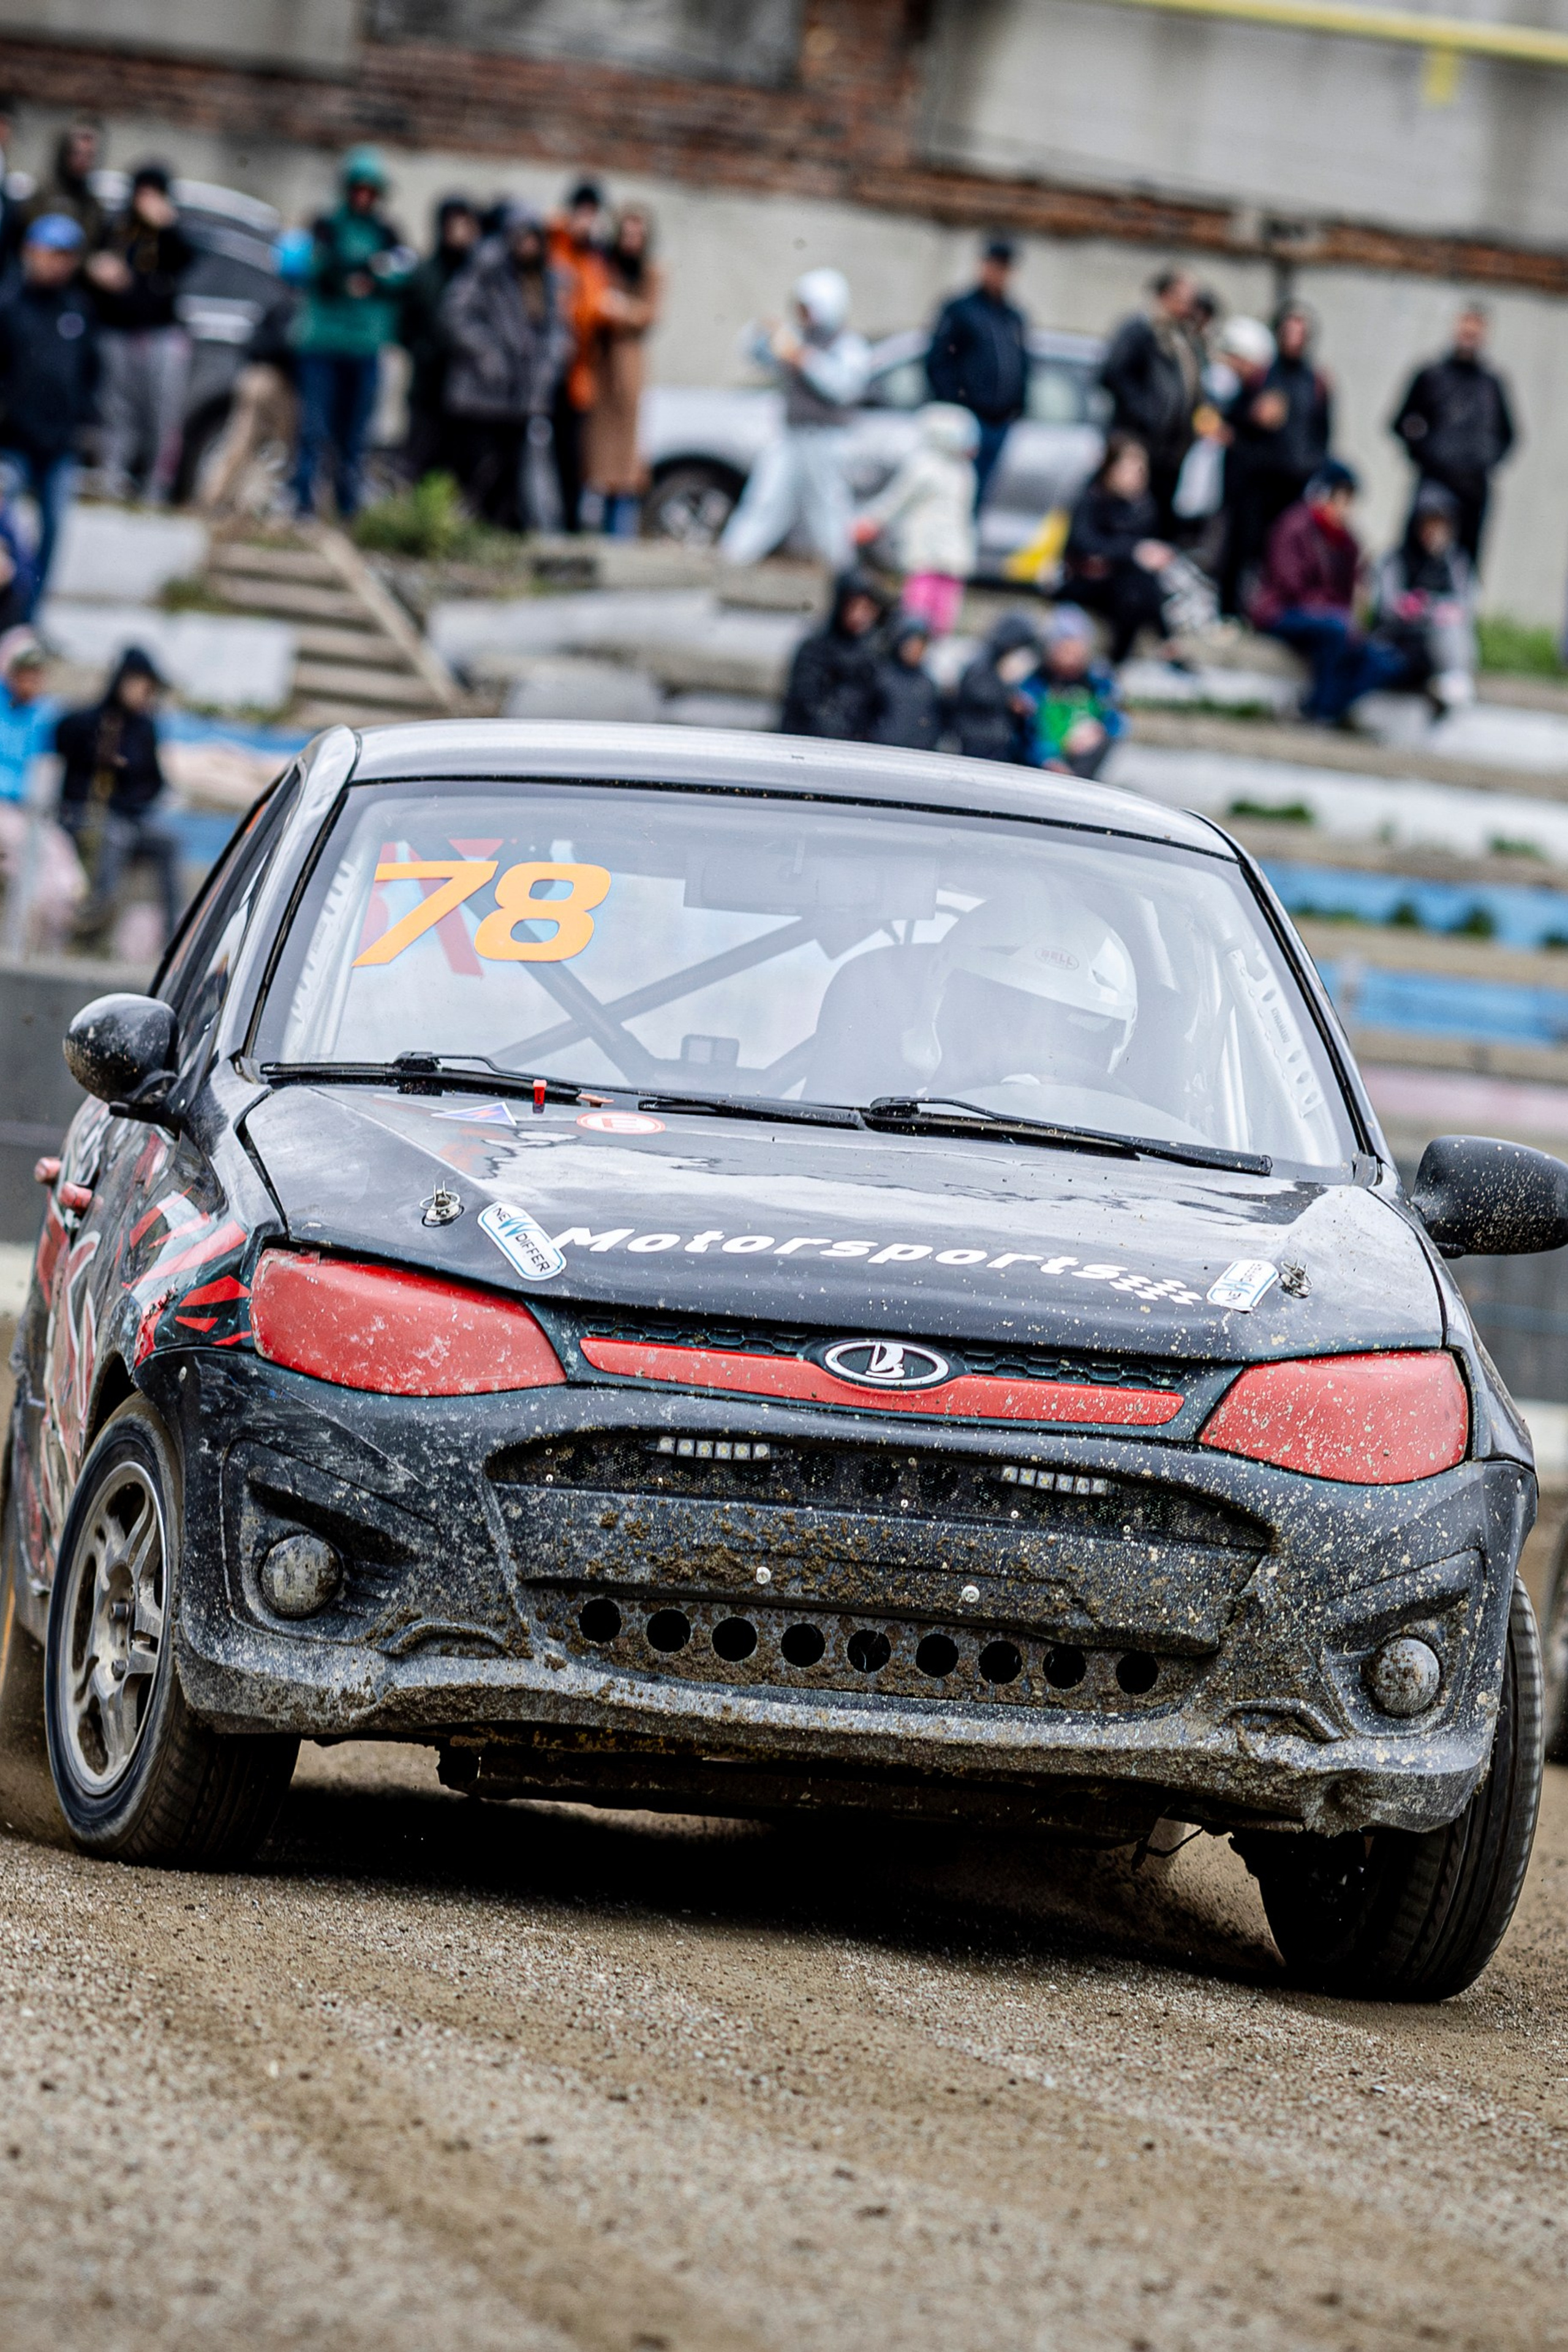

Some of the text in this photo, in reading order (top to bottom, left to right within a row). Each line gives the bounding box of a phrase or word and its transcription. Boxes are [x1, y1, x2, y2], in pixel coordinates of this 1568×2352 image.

[352, 860, 611, 967] 78
[1041, 950, 1073, 966] BELL
[515, 1232, 551, 1272] DIFFER
[549, 1226, 1129, 1280] Motorsports
